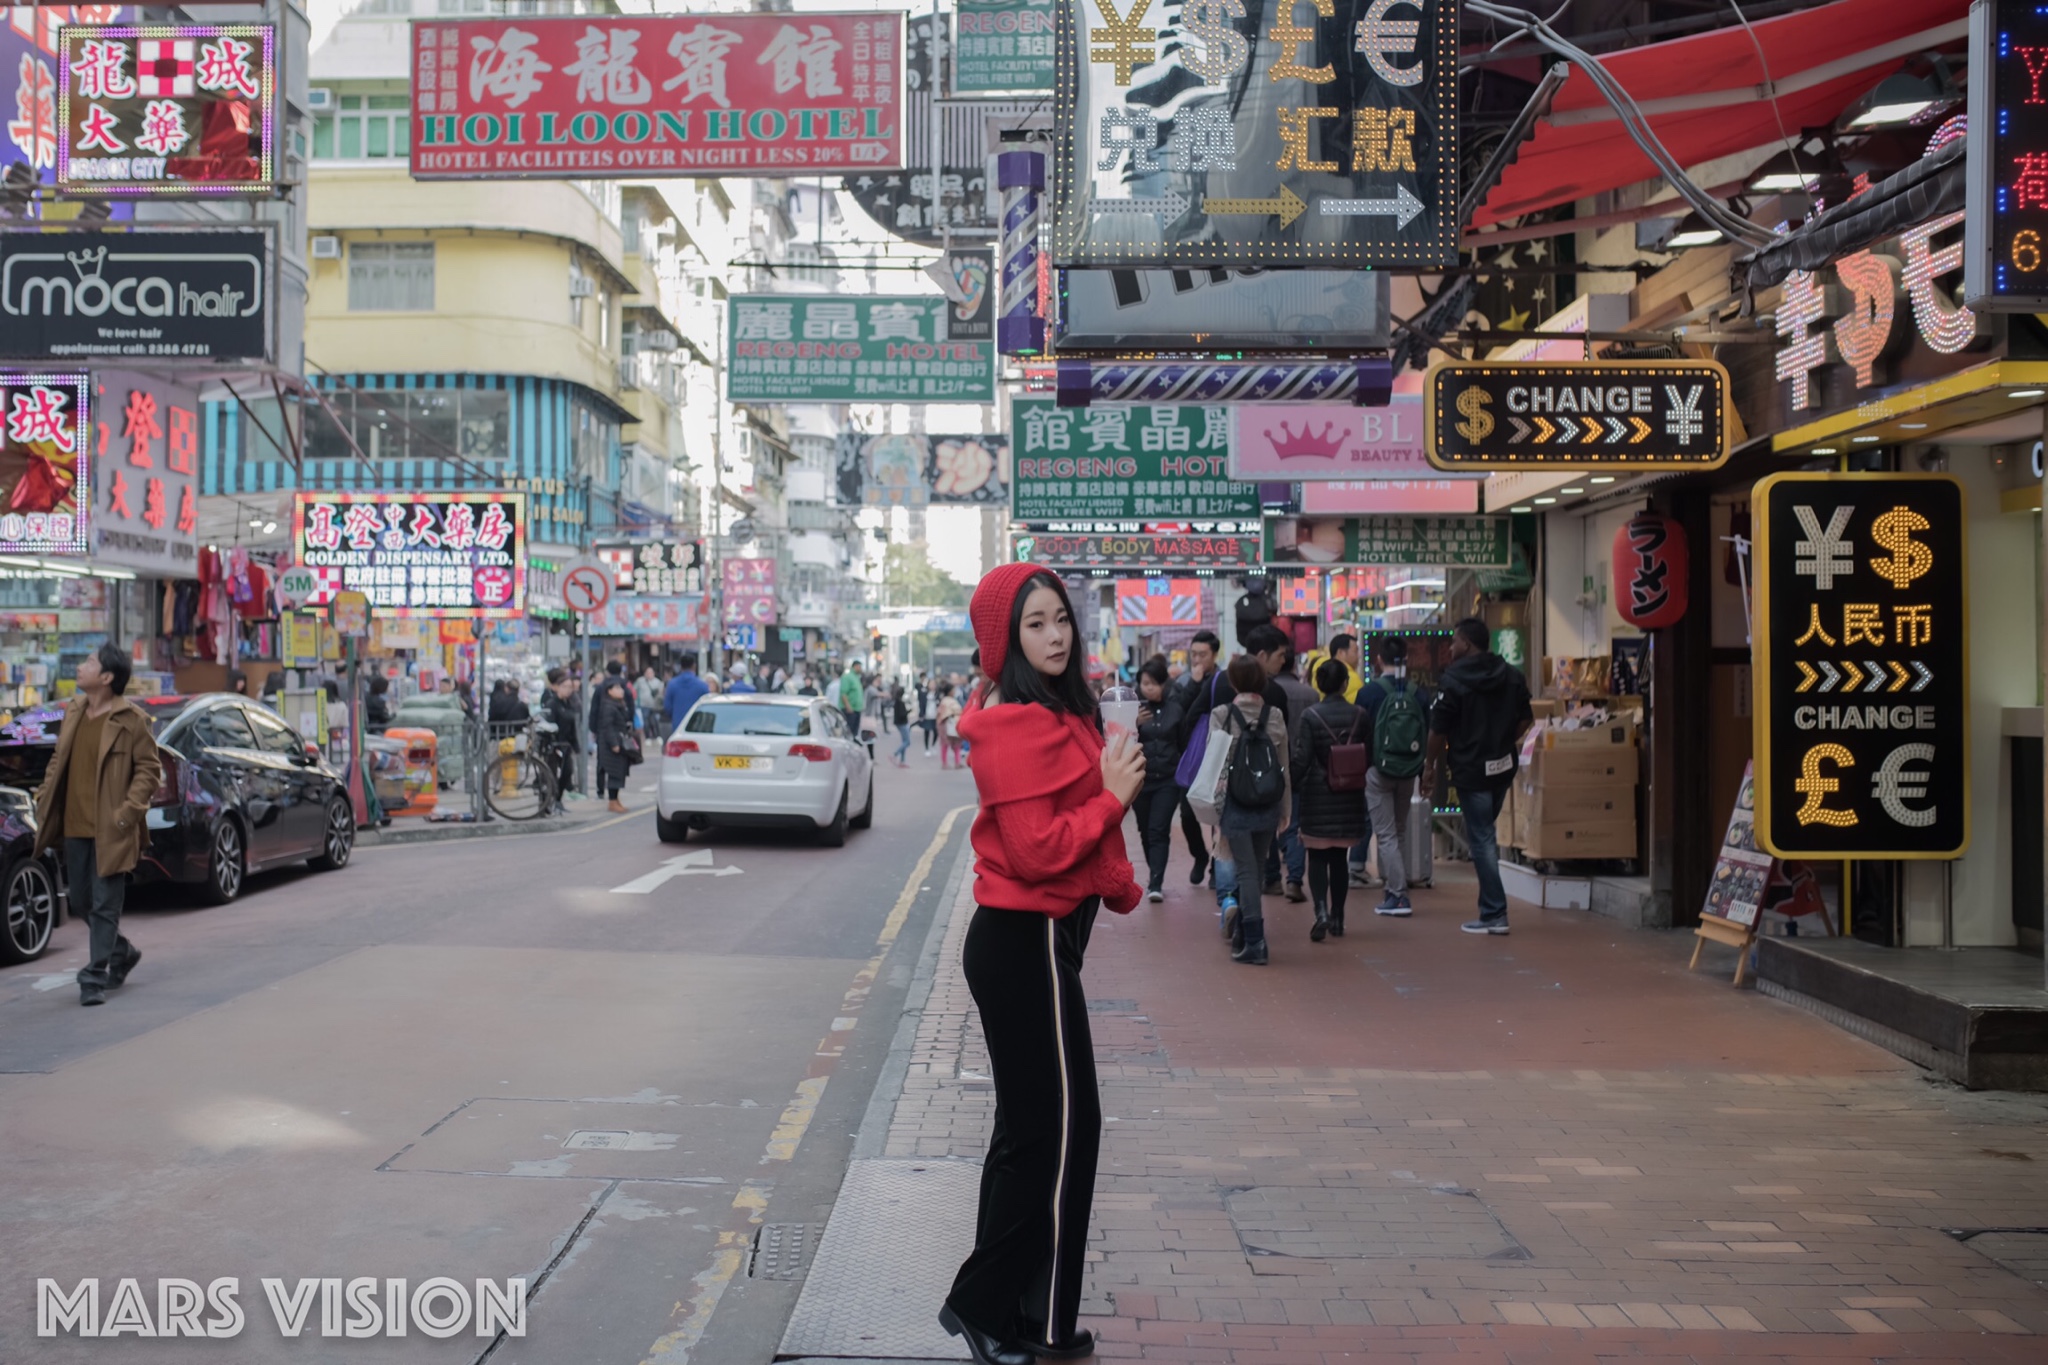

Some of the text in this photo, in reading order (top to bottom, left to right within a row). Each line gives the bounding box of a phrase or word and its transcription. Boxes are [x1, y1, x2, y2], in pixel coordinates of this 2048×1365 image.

[70, 37, 260, 100] 龍 城
[468, 23, 844, 109] 海龍賓館
[419, 107, 893, 147] HOI LOON HOTEL
[1275, 107, 1416, 172] 汇款
[67, 157, 167, 179] DRAGON CITY
[420, 152, 491, 169] HOTEL
[618, 148, 676, 166] OVER
[681, 147, 752, 165] NIGHT
[755, 147, 808, 163] LESS
[813, 147, 844, 162] 20%
[179, 281, 245, 317] hair
[50, 343, 121, 355] appointment
[736, 341, 986, 361] REGENG HOTEL
[7, 386, 76, 452] 城
[1455, 384, 1704, 445] $ CHANGE ¥
[1350, 449, 1412, 462] BEAUTY
[1018, 456, 1137, 479] REGENG
[1019, 499, 1047, 508] HOTEL
[1019, 507, 1124, 517] HOTEL FREE WIFI
[304, 551, 514, 565] GOLDEN DISPENSARY LTD.
[1036, 540, 1240, 555] FOOT & BODY MASSAGE
[1358, 553, 1496, 562] HOTEL FREE WIFI
[1792, 505, 1933, 590] ¥ $
[1629, 521, 1670, 618] ラーメン
[284, 576, 312, 592] 5M
[482, 582, 503, 602] 正
[1794, 603, 1933, 646] 人民币
[1794, 705, 1936, 730] CHANGE
[716, 758, 732, 768] VK
[1795, 743, 1937, 827] £ €
